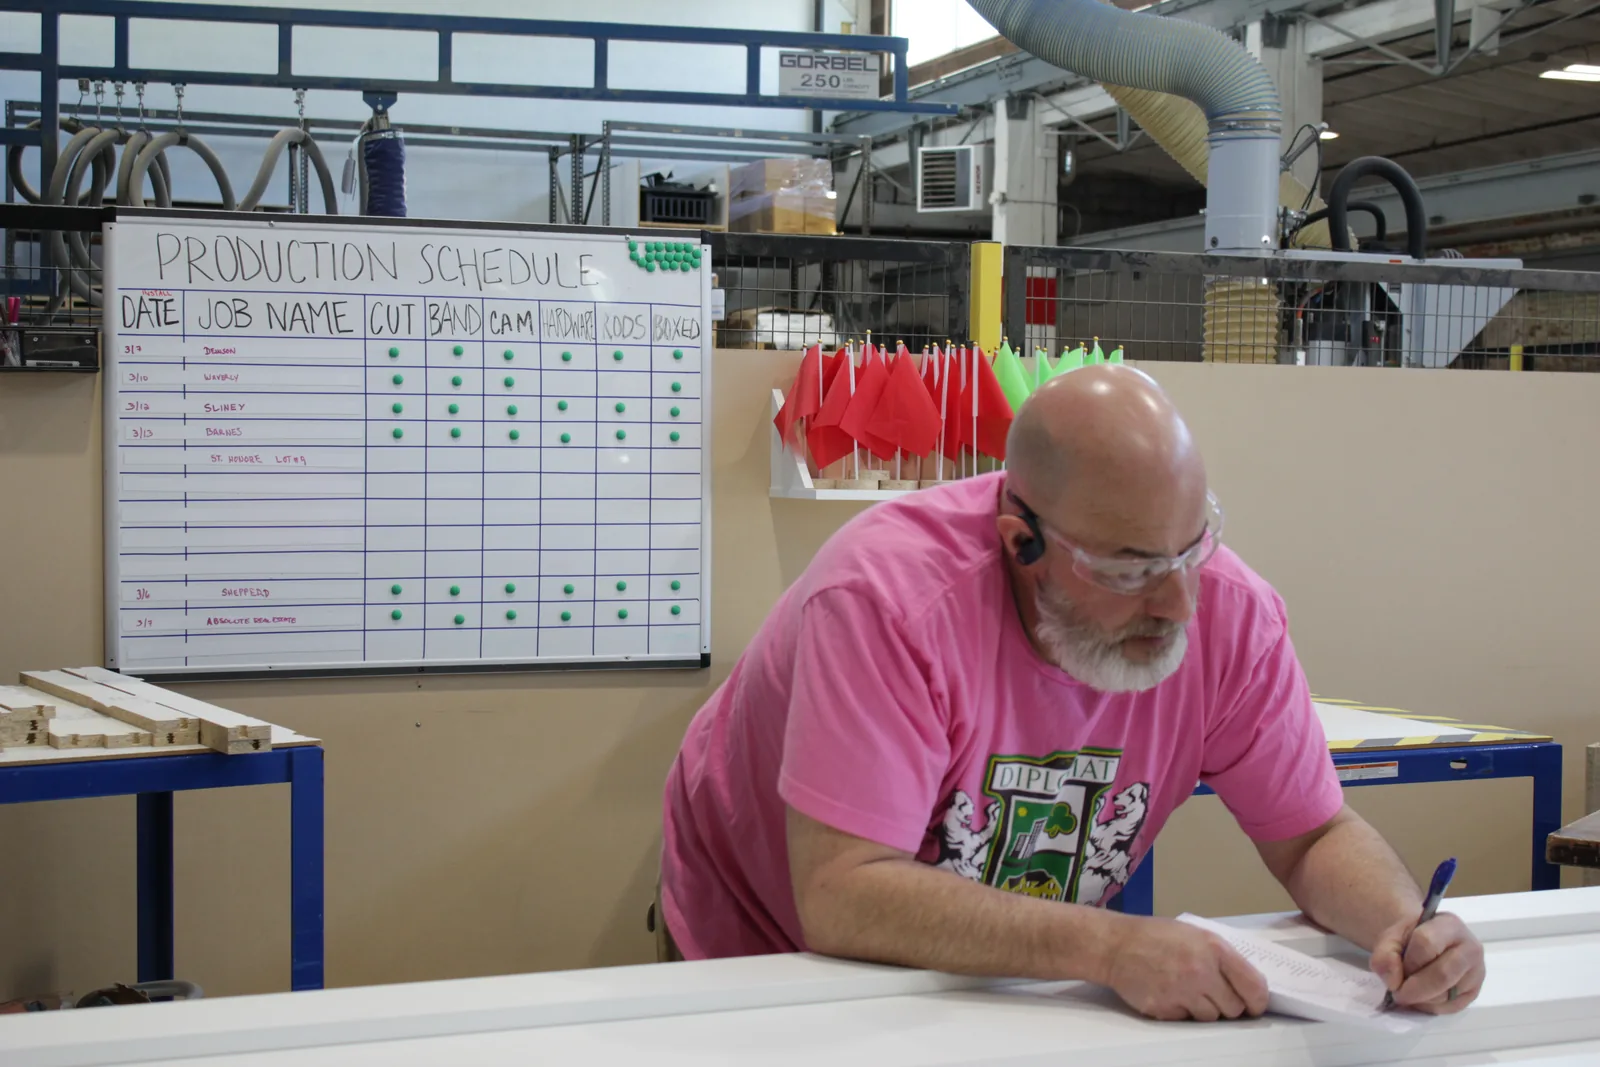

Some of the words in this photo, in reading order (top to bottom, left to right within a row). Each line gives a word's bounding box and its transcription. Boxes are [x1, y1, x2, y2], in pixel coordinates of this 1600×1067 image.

[780, 54, 878, 72] GORBEL
[800, 73, 840, 88] 250
[157, 233, 398, 283] PRODUCTION
[418, 242, 599, 291] SCHEDULE
[142, 289, 173, 297] INSTALL
[122, 295, 180, 329] DATE
[198, 298, 253, 330] JOB
[266, 300, 354, 335] NAME
[370, 301, 416, 335] CUT
[428, 301, 482, 336] BAND
[489, 310, 533, 335] CAM
[541, 307, 596, 341] HARDWARE
[602, 312, 647, 340] RODS
[652, 314, 700, 342] BOXED
[124, 345, 142, 354] 3/7
[128, 373, 148, 382] 3/10
[203, 373, 239, 382] WAVERLY
[125, 401, 150, 411] 3/12
[203, 403, 246, 412] SLINEY
[132, 427, 153, 439] 3/13
[205, 427, 243, 436] BARNES
[275, 455, 291, 463] LOT
[136, 588, 150, 600] 3/6
[136, 618, 153, 628] 3/7
[206, 617, 250, 626] ABSOLUTE
[1000, 758, 1115, 792] DIPLAT
